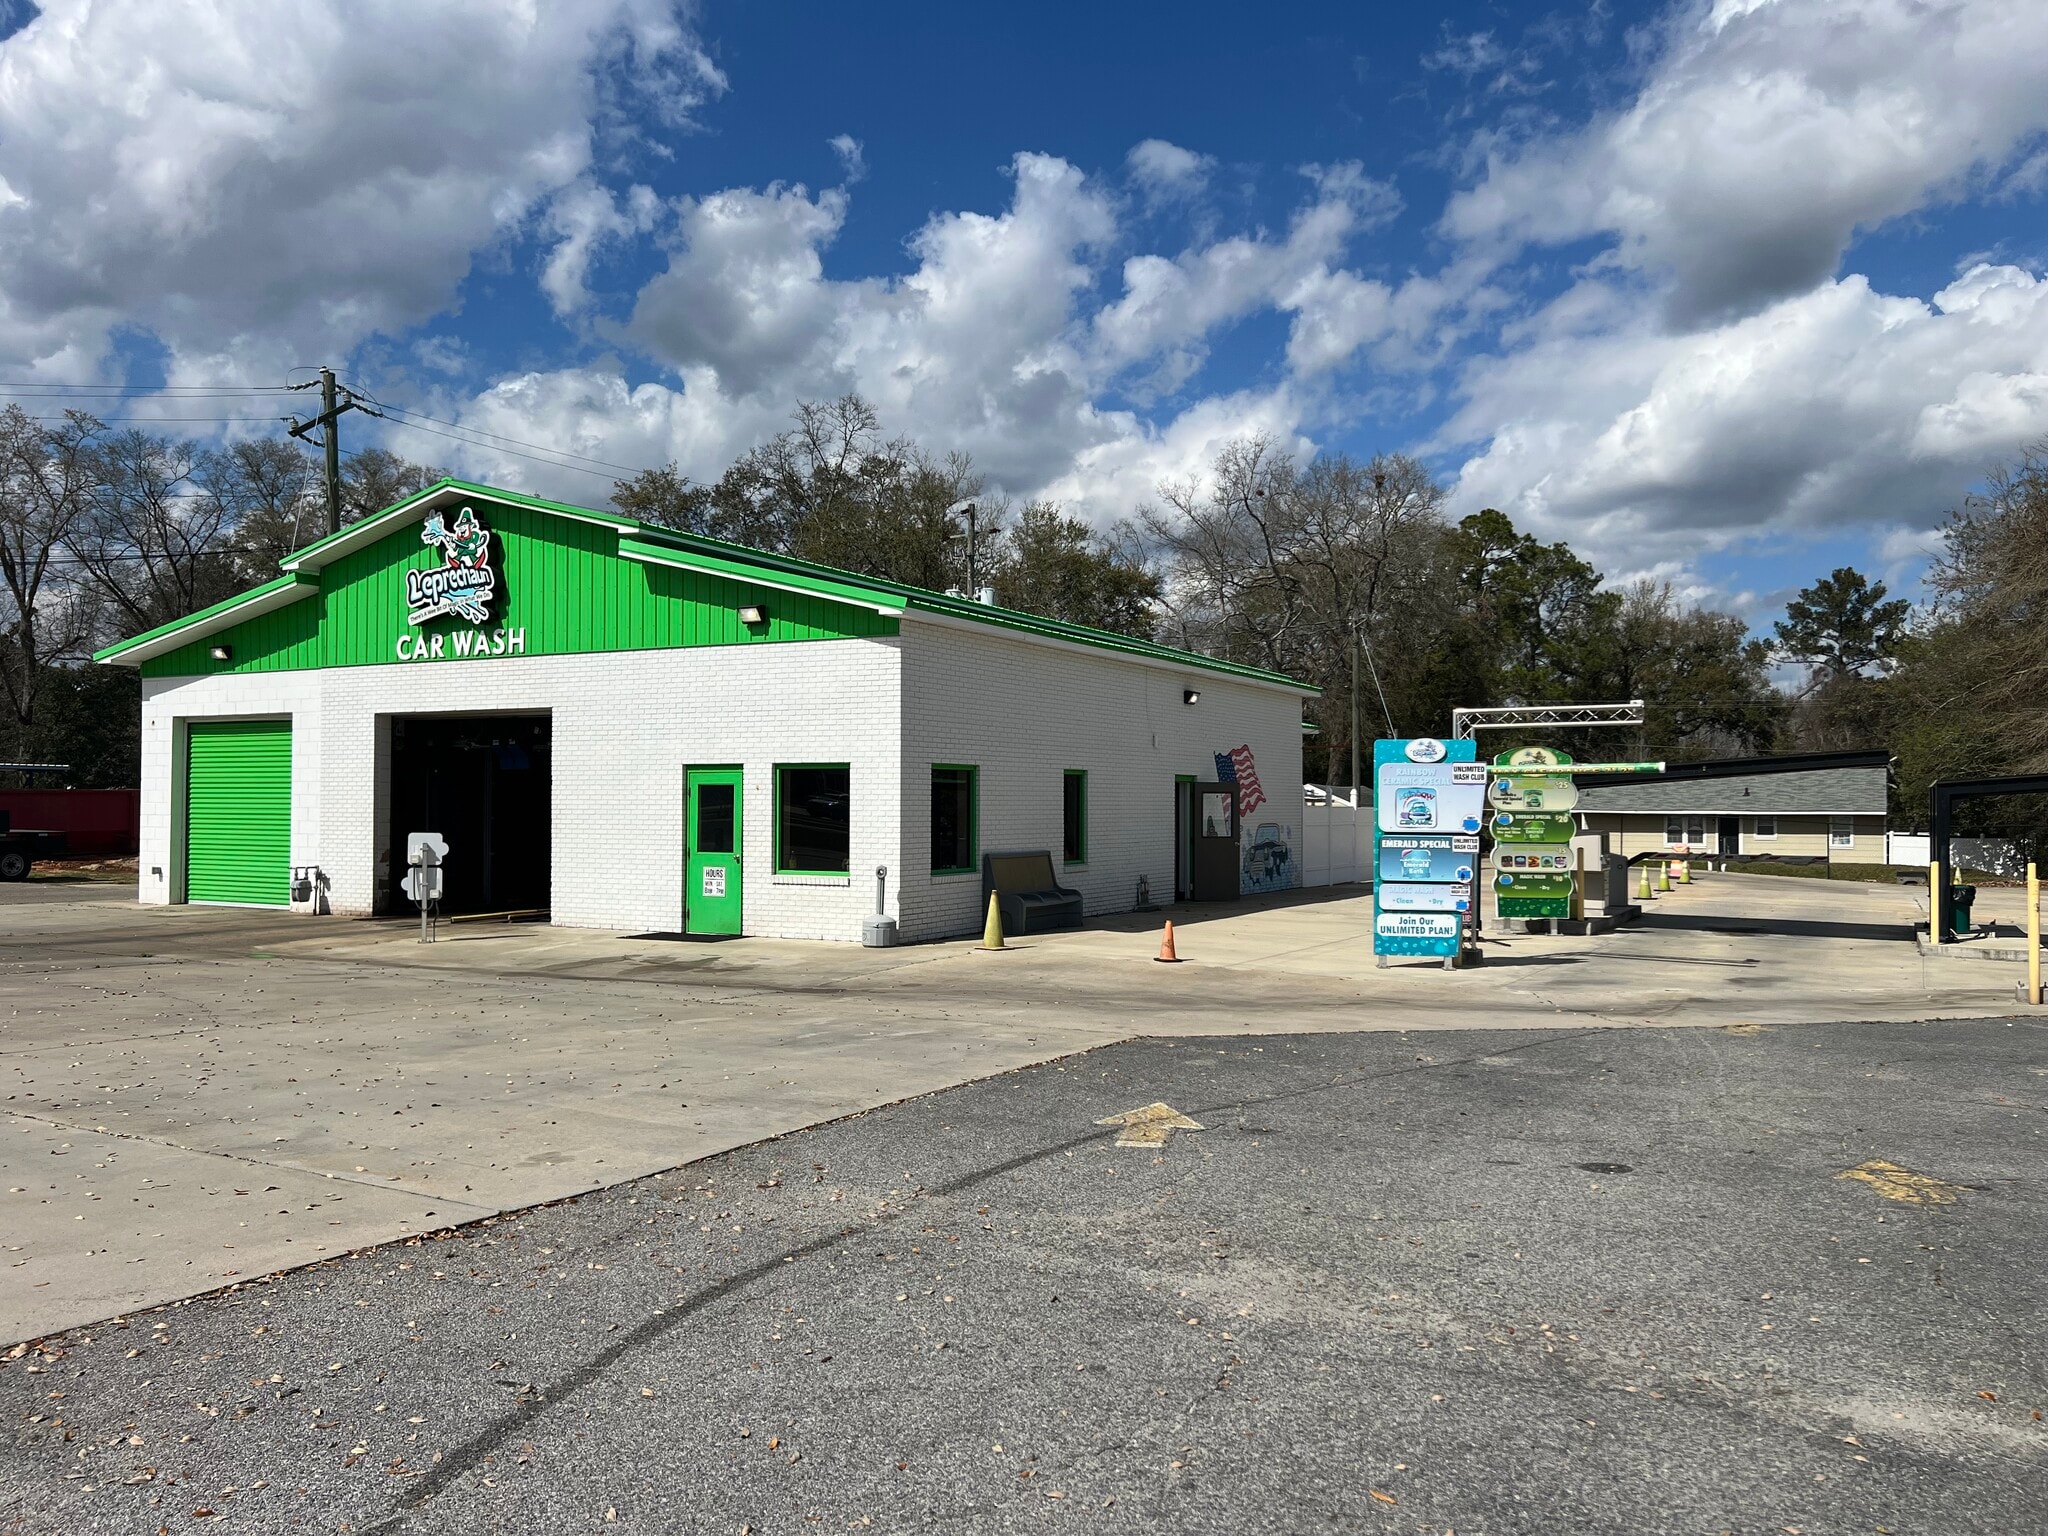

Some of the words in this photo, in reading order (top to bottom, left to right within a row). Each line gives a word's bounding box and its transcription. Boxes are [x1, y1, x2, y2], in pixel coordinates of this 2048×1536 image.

[408, 562, 490, 602] Leprechaun
[396, 633, 445, 661] CAR
[452, 627, 525, 657] WASH
[1396, 768, 1436, 776] RAINBOW
[1382, 840, 1418, 848] EMERALD
[1420, 840, 1451, 848] SPECIAL
[705, 868, 724, 878] HOURS
[1398, 916, 1416, 925] Join
[1419, 917, 1434, 925] Our
[1380, 926, 1426, 934] UNLIMITED
[1429, 926, 1453, 935] PLAN!
